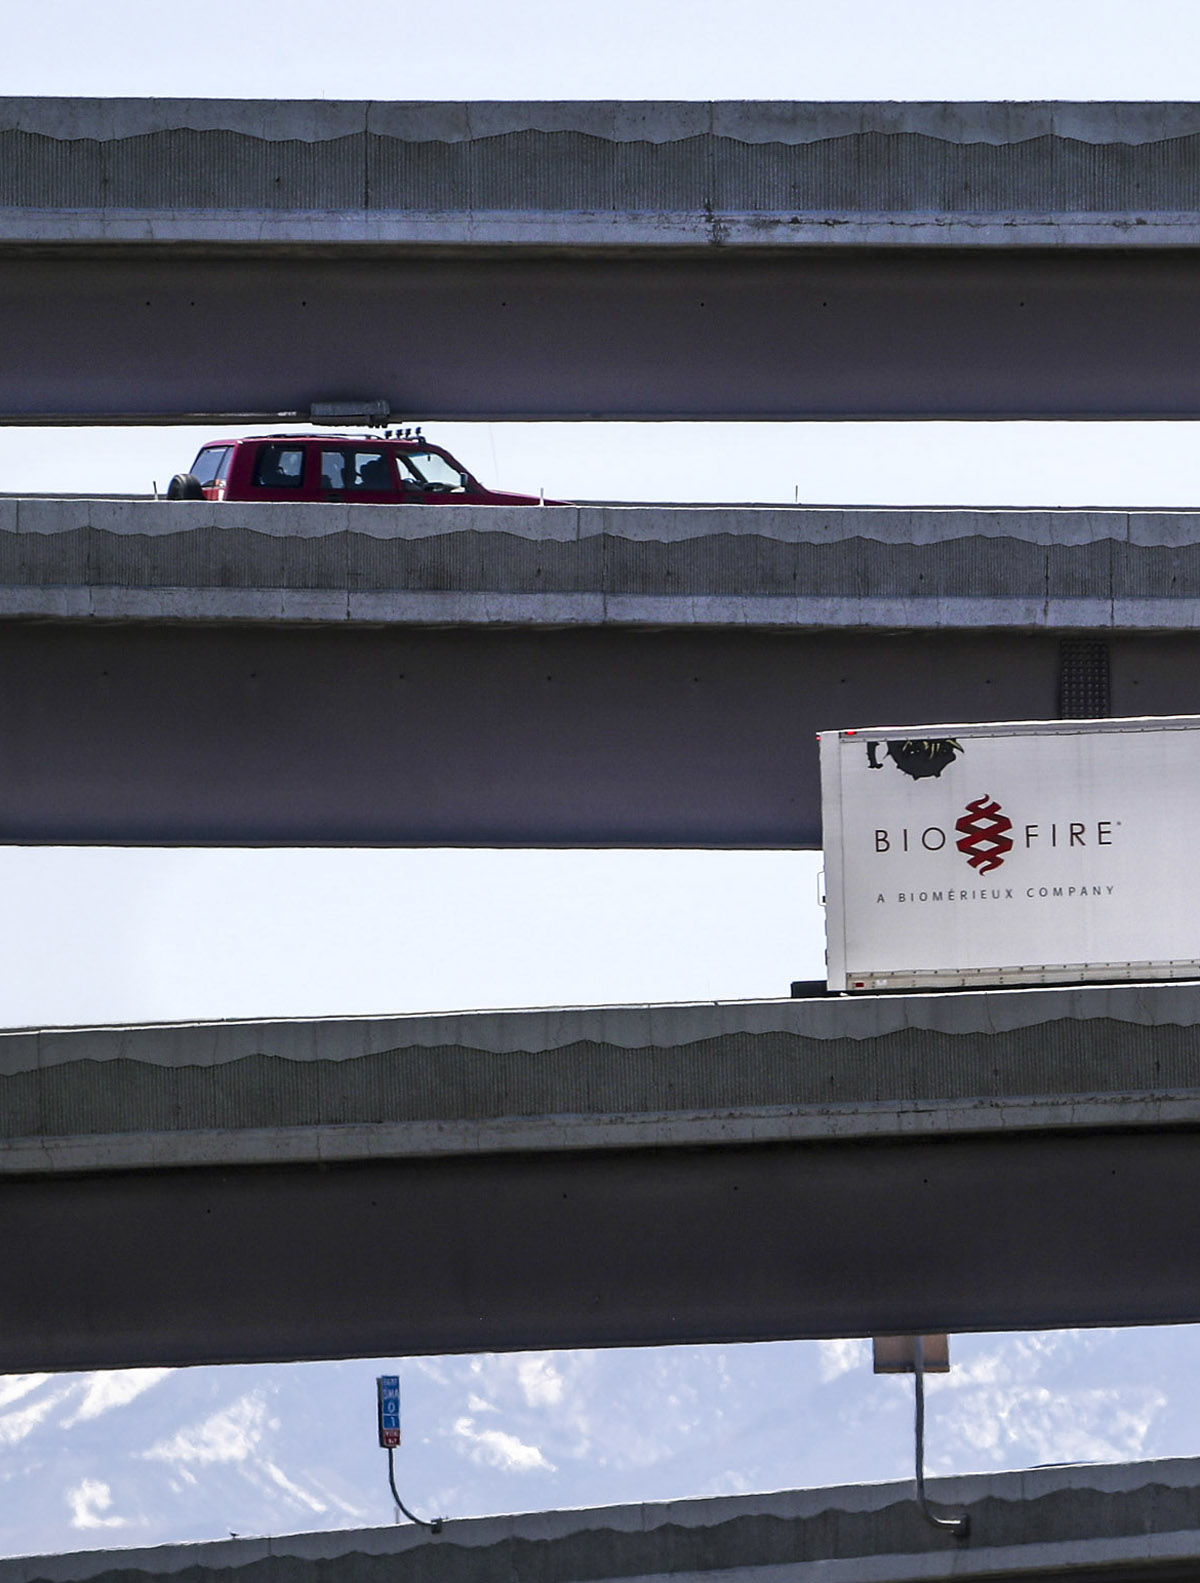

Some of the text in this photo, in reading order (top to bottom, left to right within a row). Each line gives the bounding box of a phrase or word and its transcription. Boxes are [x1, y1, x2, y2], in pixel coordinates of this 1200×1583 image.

[875, 821, 1113, 852] BIO FIRE
[876, 885, 1114, 903] A BIOMÉRIEUX COMPANY
[387, 1402, 396, 1413] 0
